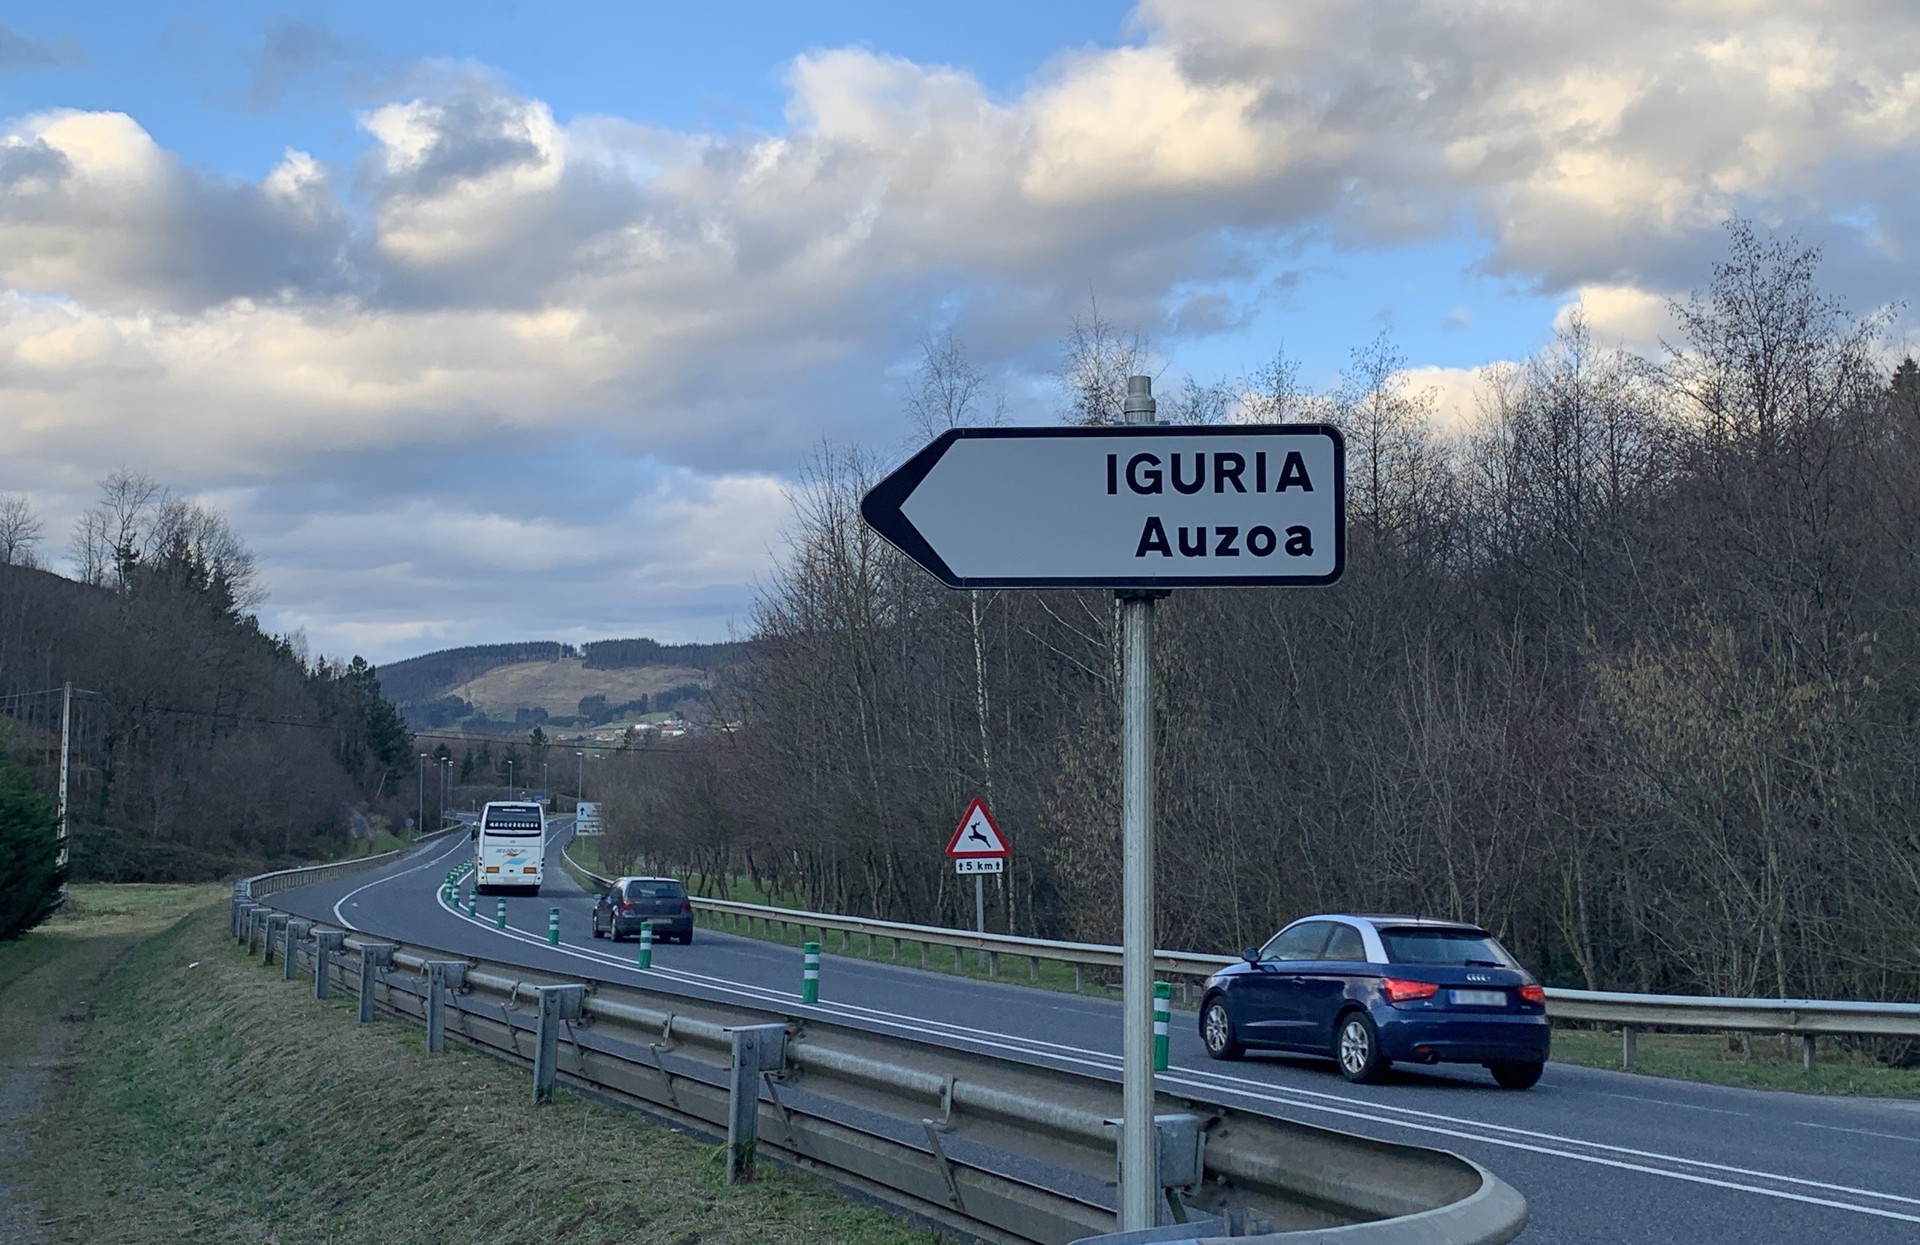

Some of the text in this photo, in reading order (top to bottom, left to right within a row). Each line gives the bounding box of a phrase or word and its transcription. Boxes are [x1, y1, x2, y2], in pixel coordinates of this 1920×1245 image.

[1107, 451, 1314, 495] IGURIA
[1136, 517, 1314, 557] Auzoa
[966, 861, 993, 871] 5 km
